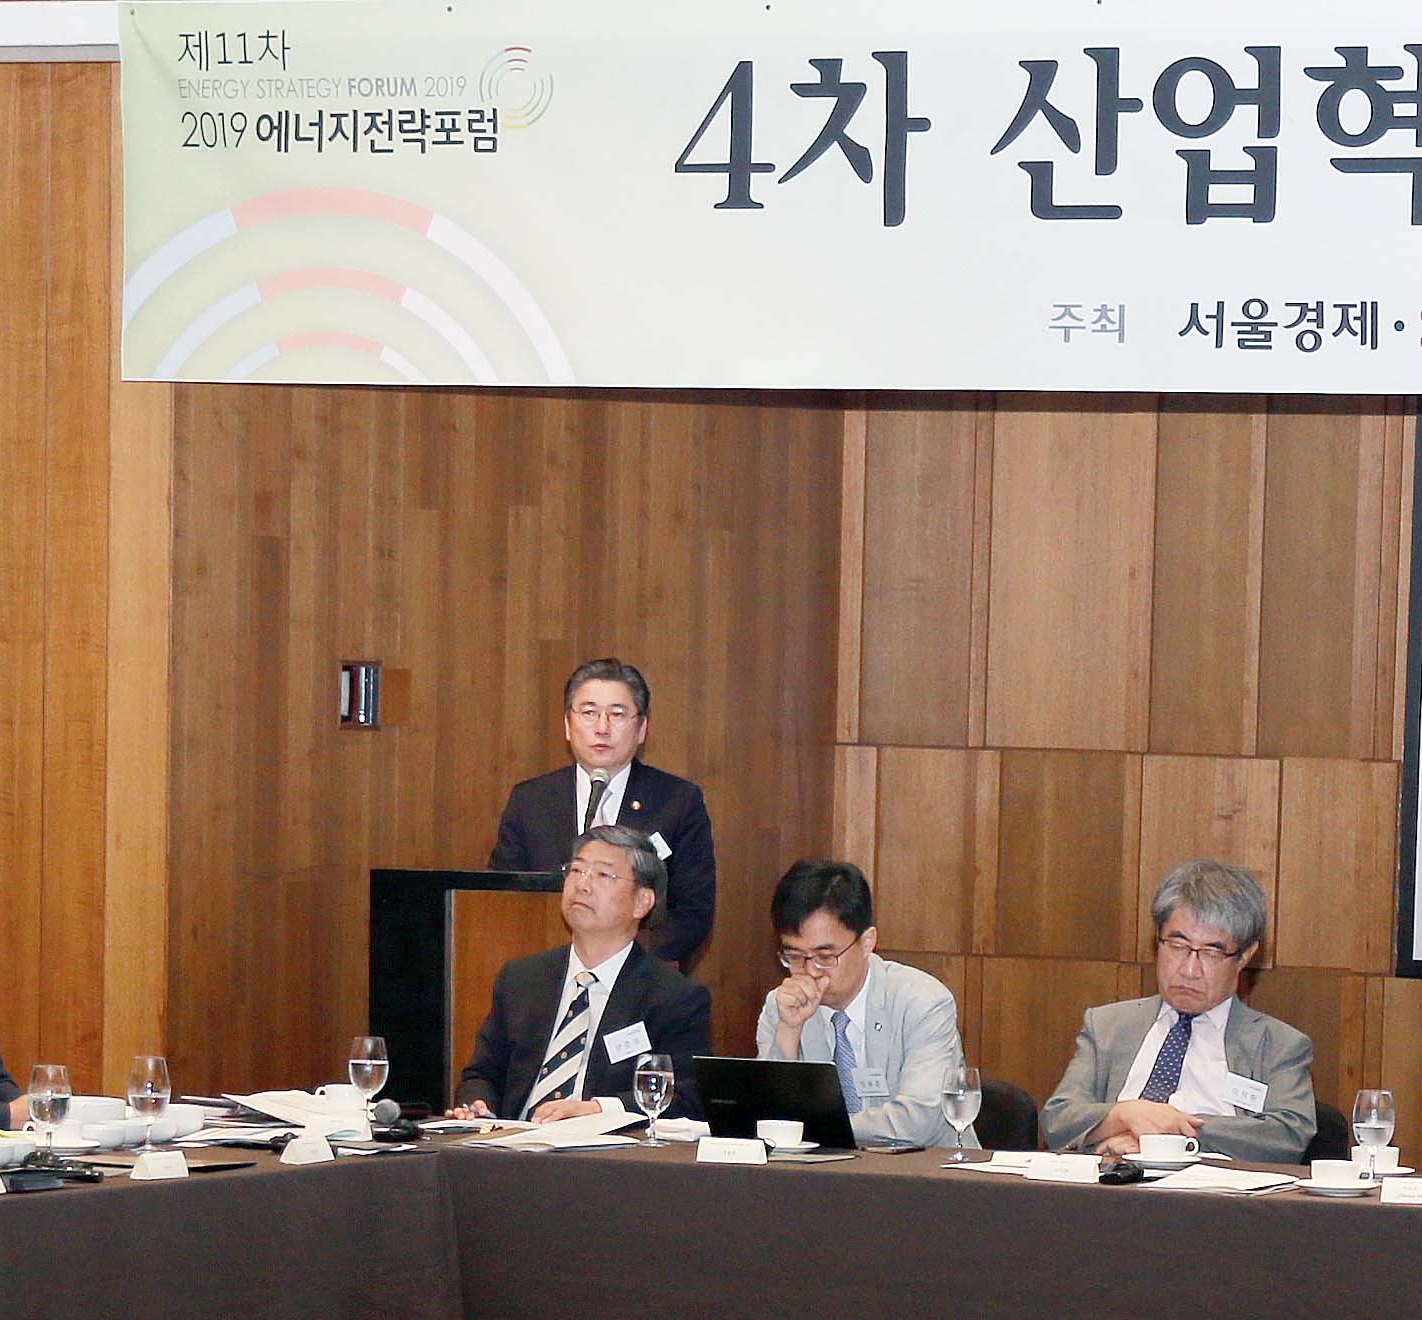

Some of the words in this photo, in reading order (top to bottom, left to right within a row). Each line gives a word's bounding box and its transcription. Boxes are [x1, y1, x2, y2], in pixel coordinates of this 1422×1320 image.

[177, 29, 291, 72] 제11차
[178, 78, 250, 99] ENERGY
[256, 77, 341, 99] STRATEGY
[347, 76, 418, 98] FORUM
[424, 75, 467, 98] 2019
[180, 111, 248, 149] 2019
[255, 107, 499, 154] 에너지전략포럼
[674, 50, 932, 228] 4차
[1048, 303, 1126, 344] 주최
